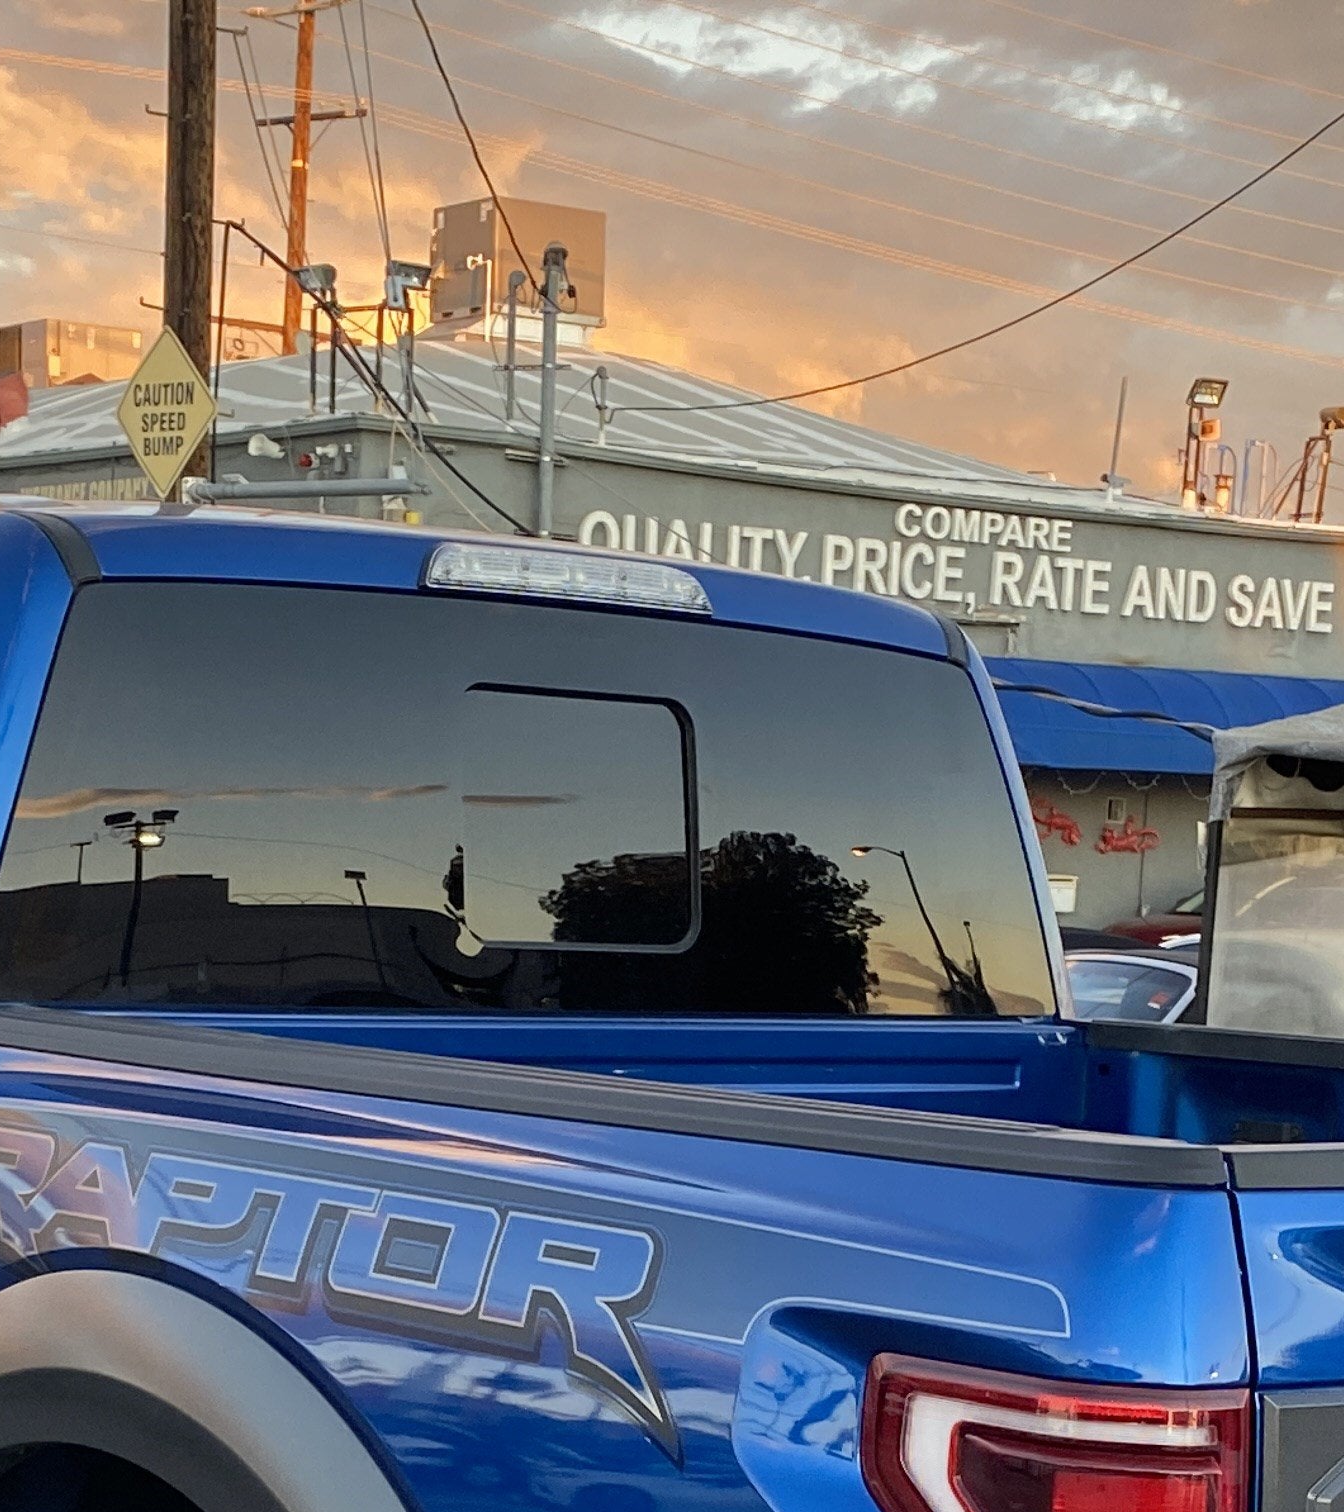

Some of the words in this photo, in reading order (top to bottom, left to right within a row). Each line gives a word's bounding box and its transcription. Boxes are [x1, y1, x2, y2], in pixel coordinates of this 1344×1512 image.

[133, 381, 195, 407] CAUTION
[141, 412, 186, 433] SPEED
[143, 436, 184, 457] BUMP
[895, 502, 1073, 552] COMPARE
[820, 533, 976, 614] PRICE,
[989, 551, 1112, 615] RATE
[1121, 564, 1217, 624] AND
[1225, 574, 1336, 634] SAVE
